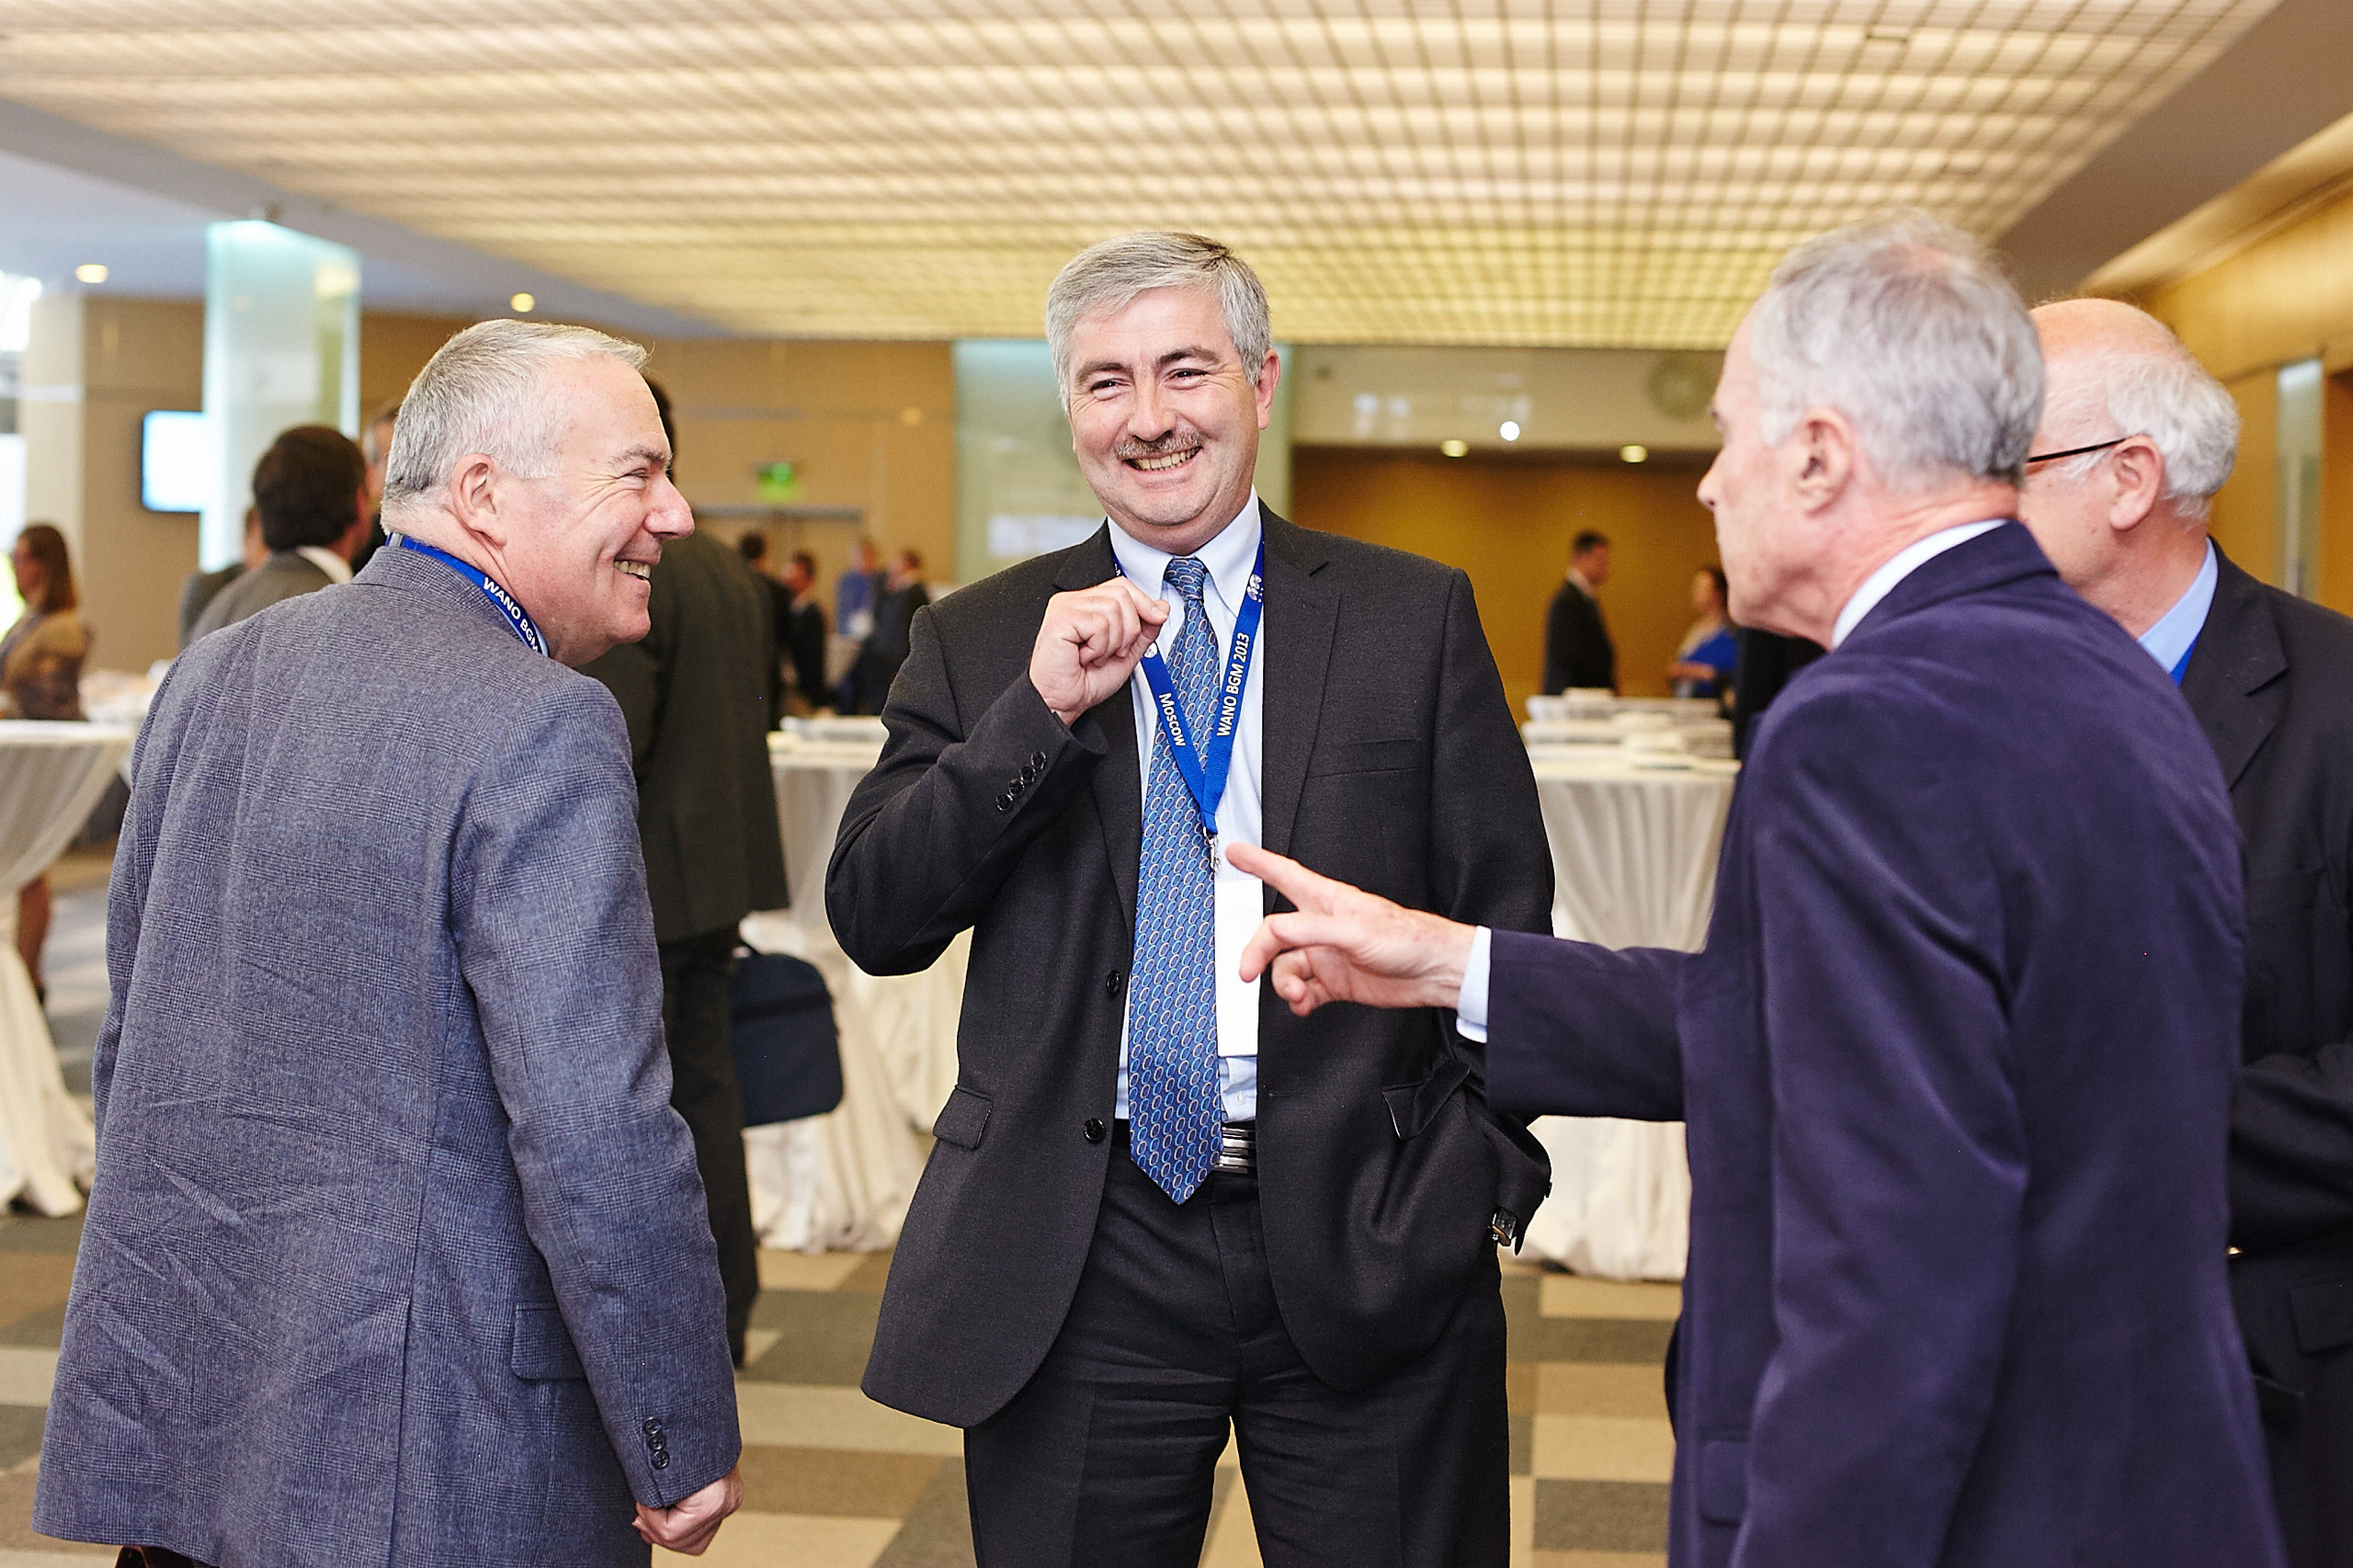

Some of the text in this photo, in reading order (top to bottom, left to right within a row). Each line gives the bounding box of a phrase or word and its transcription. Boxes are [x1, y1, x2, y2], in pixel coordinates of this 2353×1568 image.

[483, 577, 539, 653] WANO BGM
[1216, 631, 1250, 736] WANO BGM 2013
